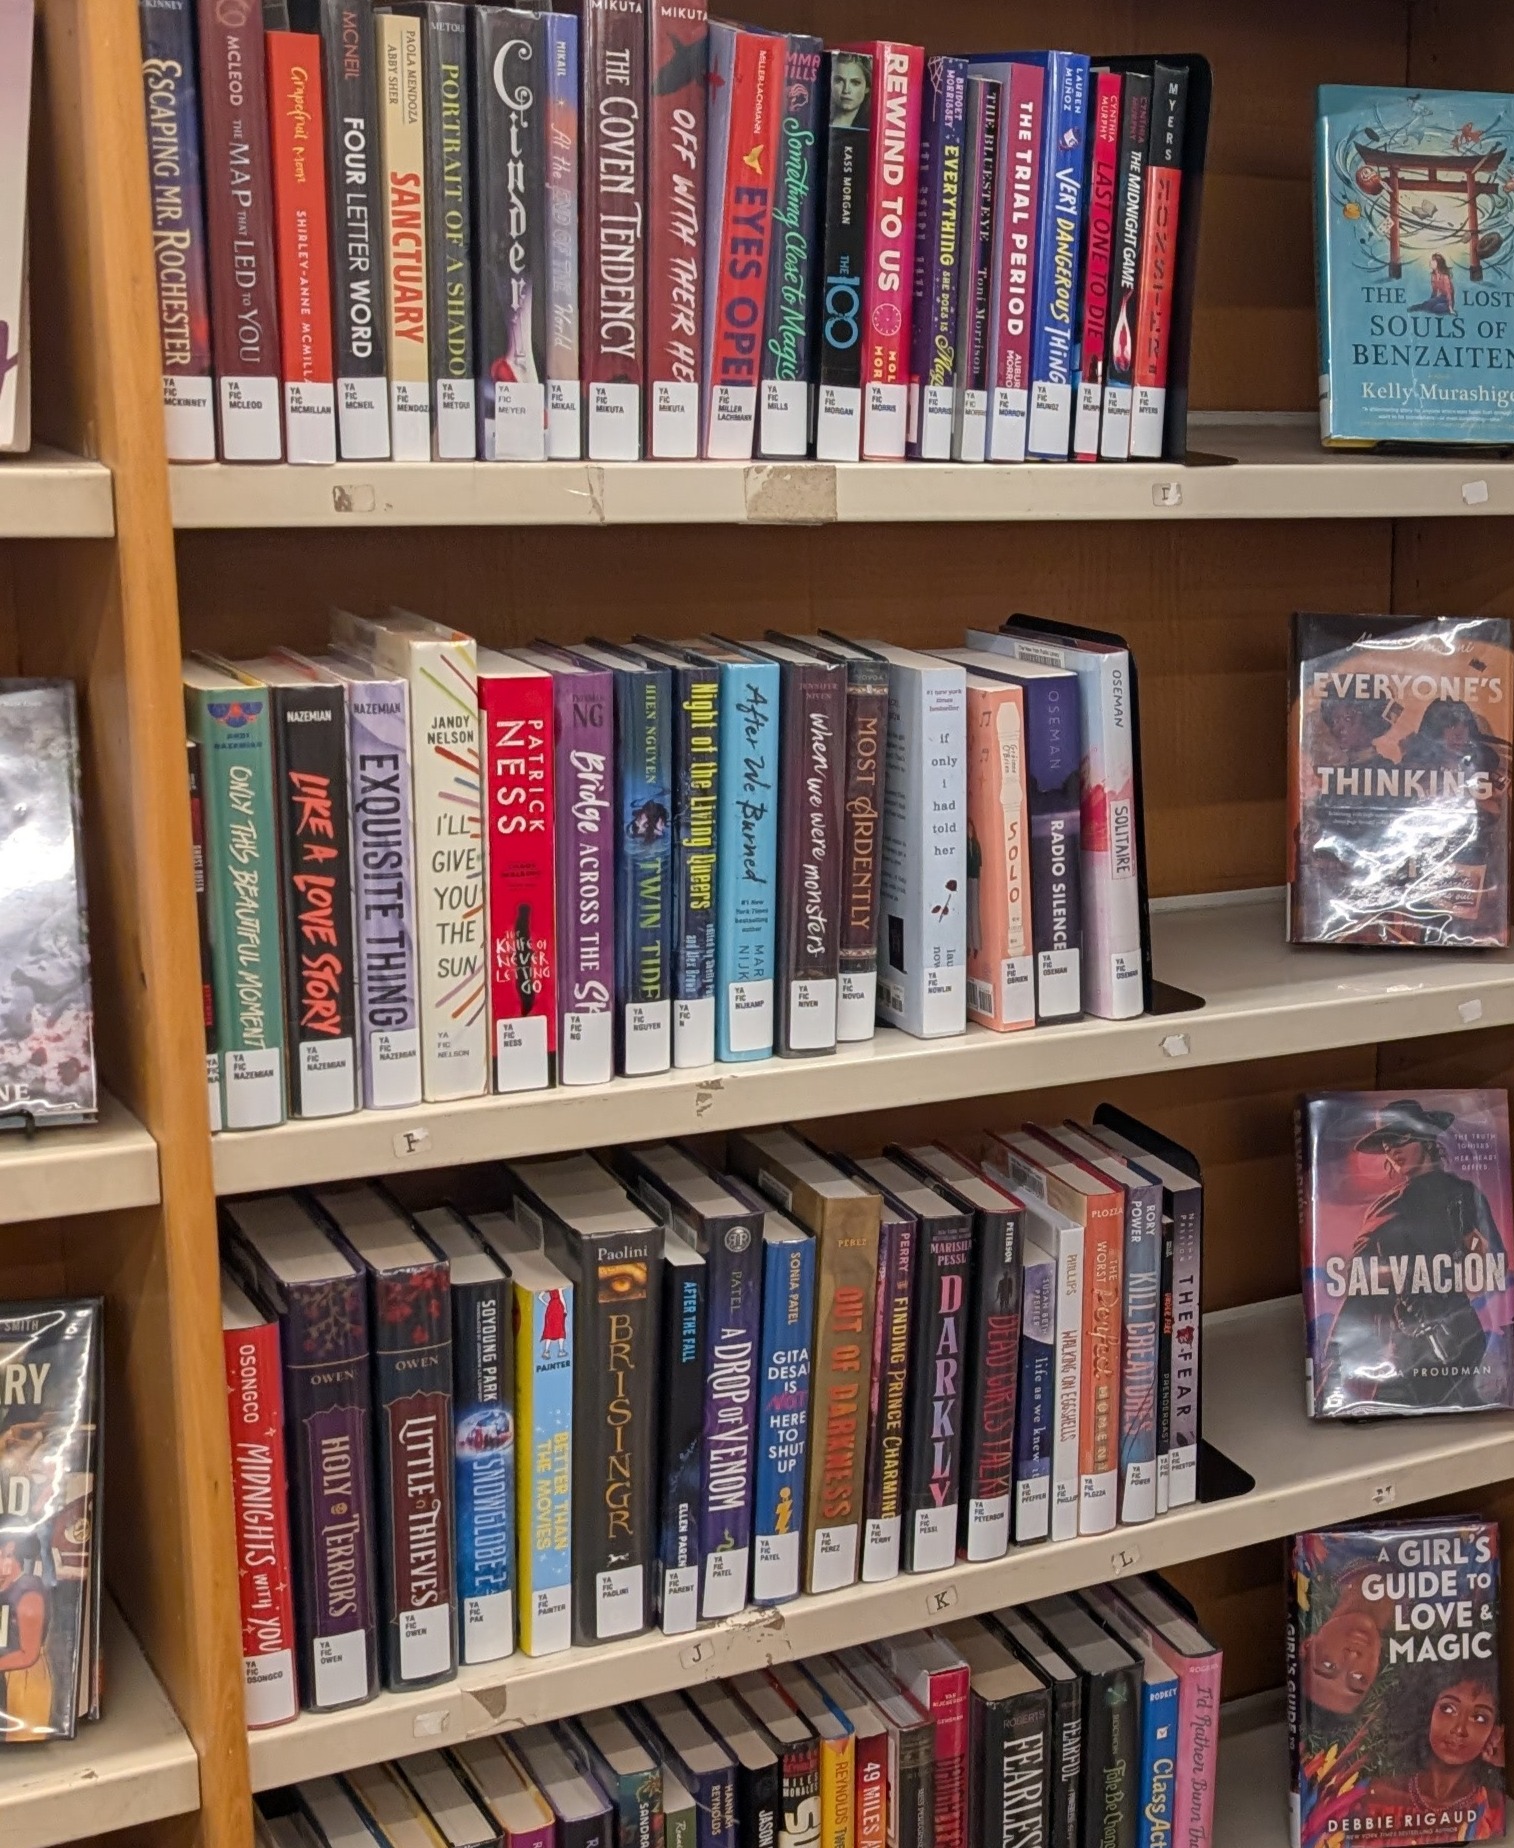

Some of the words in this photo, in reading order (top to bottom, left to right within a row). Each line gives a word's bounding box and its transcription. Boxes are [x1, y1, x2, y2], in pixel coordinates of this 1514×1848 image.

[605, 49, 630, 85] THE
[1063, 67, 1072, 112] MUÑOZ
[1073, 67, 1083, 114] LAUREN
[142, 58, 180, 176] ESCAPING
[881, 52, 909, 187] REWIND
[1017, 102, 1033, 140] THE
[343, 117, 366, 186] FOUR
[599, 96, 638, 195] COVEN
[843, 145, 852, 176] KASS
[493, 39, 533, 311] Cinder
[1012, 149, 1033, 224] TRIAL
[155, 181, 181, 226] MR.
[841, 177, 851, 224] MORGAN
[345, 188, 369, 273] LETTER
[880, 196, 903, 239] TO
[389, 171, 424, 344] SANCTUARY
[839, 256, 849, 274] THE
[877, 250, 901, 292] US
[599, 202, 642, 359] TENDENCY
[1007, 233, 1029, 336] PERIOD
[155, 228, 192, 367] ROCHESTER
[1361, 286, 1406, 304] THE
[1462, 290, 1514, 308] LOST
[349, 281, 371, 358] WORD
[1370, 315, 1465, 339] SOULS
[1477, 321, 1507, 339] OF
[228, 382, 239, 391] YA
[229, 392, 241, 400] FIC
[1362, 381, 1413, 404] Kelly
[229, 400, 262, 409] MCLEOD
[1112, 669, 1124, 728] OSEMAN
[1313, 672, 1503, 702] EVERYONE'S
[431, 716, 470, 729] JANDY
[744, 682, 770, 749] After
[427, 730, 474, 744] NELSON
[855, 717, 877, 786] MOST
[939, 733, 950, 744] if
[496, 720, 526, 834] NESS
[527, 719, 544, 832] PATRICK
[743, 757, 771, 793] We
[932, 756, 958, 768] only
[1317, 766, 1493, 800] THINKING
[288, 772, 334, 839] LIKE
[933, 800, 956, 811] had
[356, 755, 403, 921] EXQUISITE
[437, 815, 470, 835] I'LL
[932, 823, 957, 834] told
[1112, 806, 1130, 875] SOLITAIRE
[303, 843, 338, 862] A
[736, 799, 767, 884] Burned
[933, 845, 955, 856] her
[1049, 819, 1066, 877] RADIO
[432, 851, 477, 873] GIVE
[846, 794, 874, 930] ARDENTLY
[1008, 821, 1019, 904] SOLO
[294, 874, 338, 949] LOVE
[434, 887, 477, 910] YOU
[1052, 881, 1067, 950] SILENCE
[436, 923, 476, 944] THE
[438, 958, 477, 978] SUN
[301, 953, 342, 1035] STORY
[307, 1046, 318, 1054] YA
[503, 1038, 523, 1047] NESS
[504, 1031, 515, 1039] FIC
[307, 1054, 320, 1062] FIC
[307, 1061, 346, 1071] NAZEMIAN
[1131, 1200, 1142, 1243] POWER
[1146, 1204, 1156, 1235] RORY
[598, 1245, 648, 1262] Paolini
[930, 1241, 972, 1254] MARISHA
[938, 1254, 966, 1266] PESSL
[1178, 1274, 1194, 1323] THE
[536, 1361, 571, 1372] PAINTER
[773, 1349, 808, 1364] GITA
[1413, 1365, 1492, 1377] PROUDMAN
[784, 1382, 797, 1394] IS
[1176, 1350, 1192, 1417] FEAR
[607, 1315, 633, 1540] BRISINGR
[770, 1413, 805, 1426] HERE
[777, 1429, 797, 1441] TO
[398, 1414, 437, 1500] LITTLE
[769, 1443, 804, 1457] SHUT
[777, 1459, 796, 1473] UP
[320, 1436, 351, 1498] HOLY
[322, 1512, 360, 1617] TERRORS
[405, 1499, 441, 1609] THIEVES
[1120, 1551, 1133, 1566] L
[1378, 1547, 1390, 1563] A
[1398, 1537, 1491, 1567] GIRL'S
[933, 1593, 950, 1610] K
[1362, 1570, 1457, 1601] GUIDE
[1467, 1573, 1491, 1589] TO
[1395, 1603, 1473, 1631] LOVE
[1480, 1605, 1493, 1620] &
[1390, 1632, 1493, 1664] MAGIC
[1150, 1687, 1177, 1702] RODKEY
[1061, 1720, 1081, 1782] FEARFUL
[1328, 1816, 1394, 1832] DEBBIE
[1405, 1810, 1477, 1827] RIGAUD
